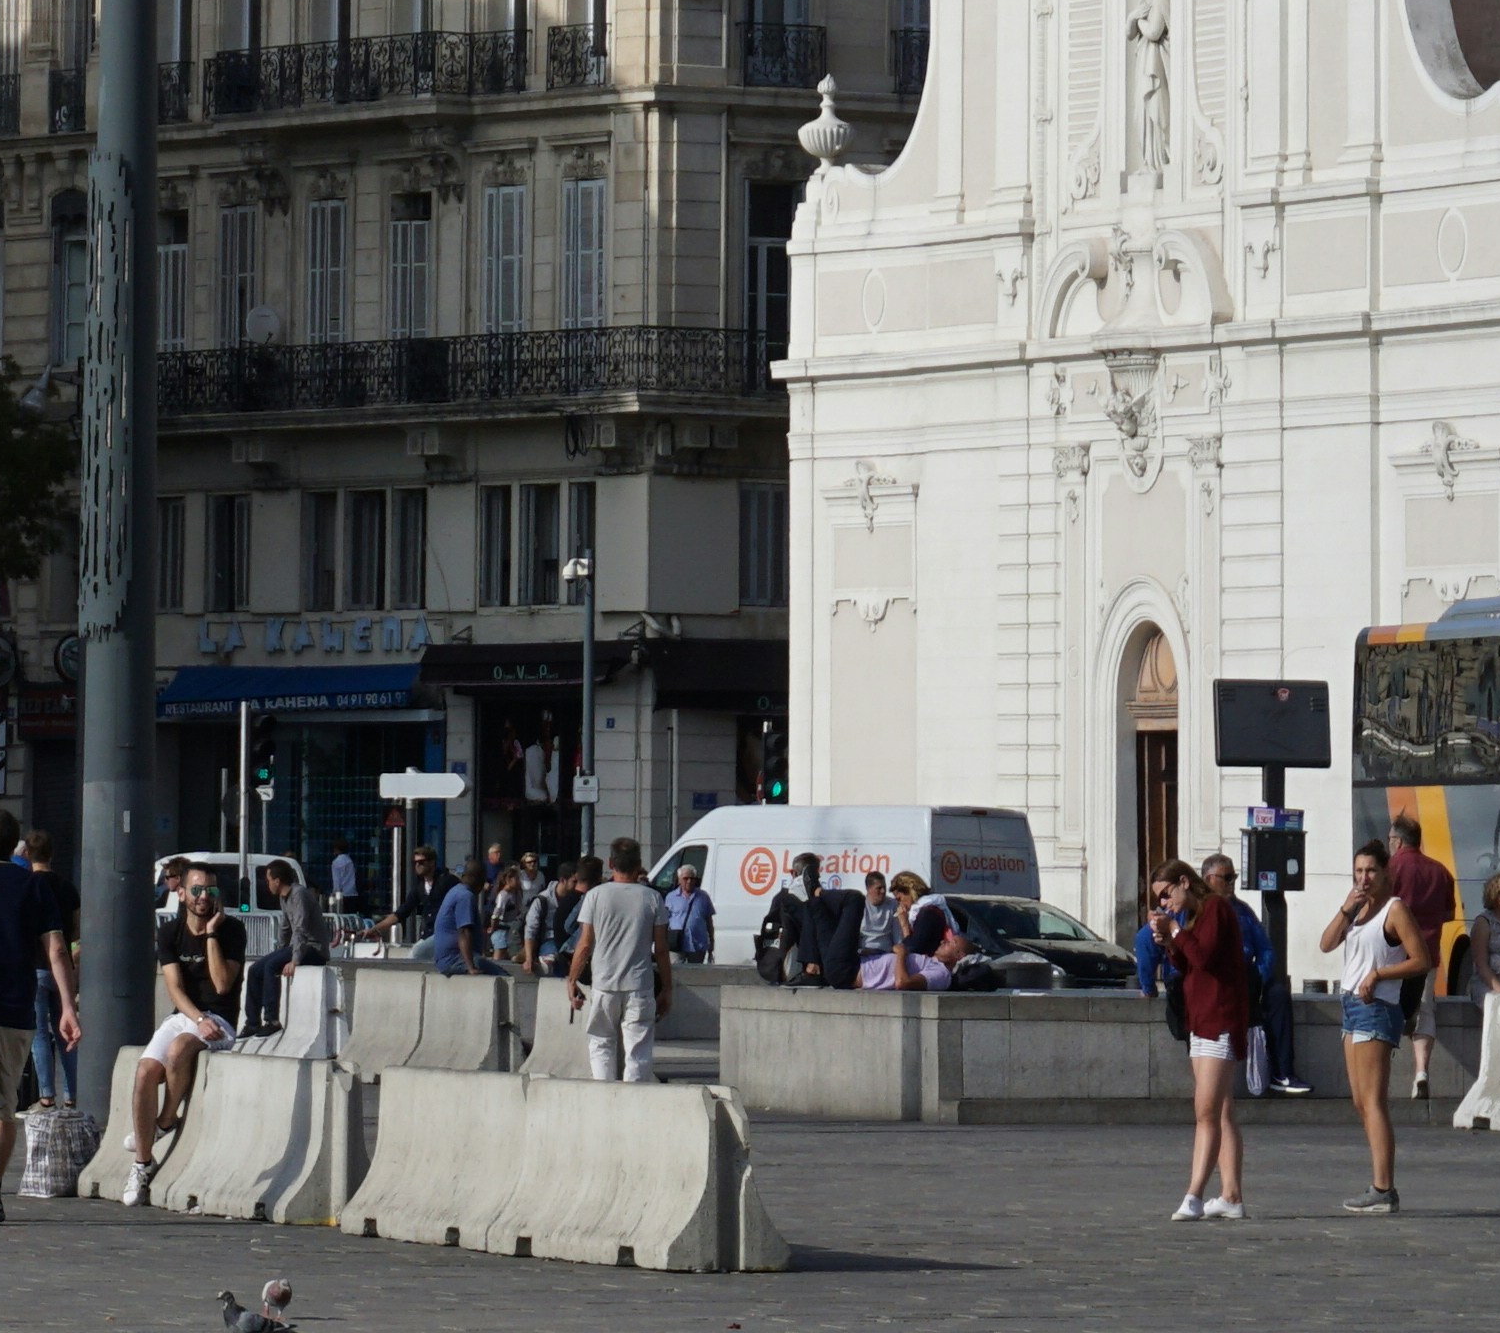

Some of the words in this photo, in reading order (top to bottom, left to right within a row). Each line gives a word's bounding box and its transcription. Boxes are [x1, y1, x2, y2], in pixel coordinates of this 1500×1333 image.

[199, 618, 246, 654] LA
[265, 614, 432, 653] KAHENA
[165, 701, 234, 714] RESTAURANT
[337, 694, 348, 706] 04
[351, 694, 362, 706] 91
[365, 693, 377, 705] 90
[380, 693, 391, 704] 61
[964, 853, 1026, 872] Location
